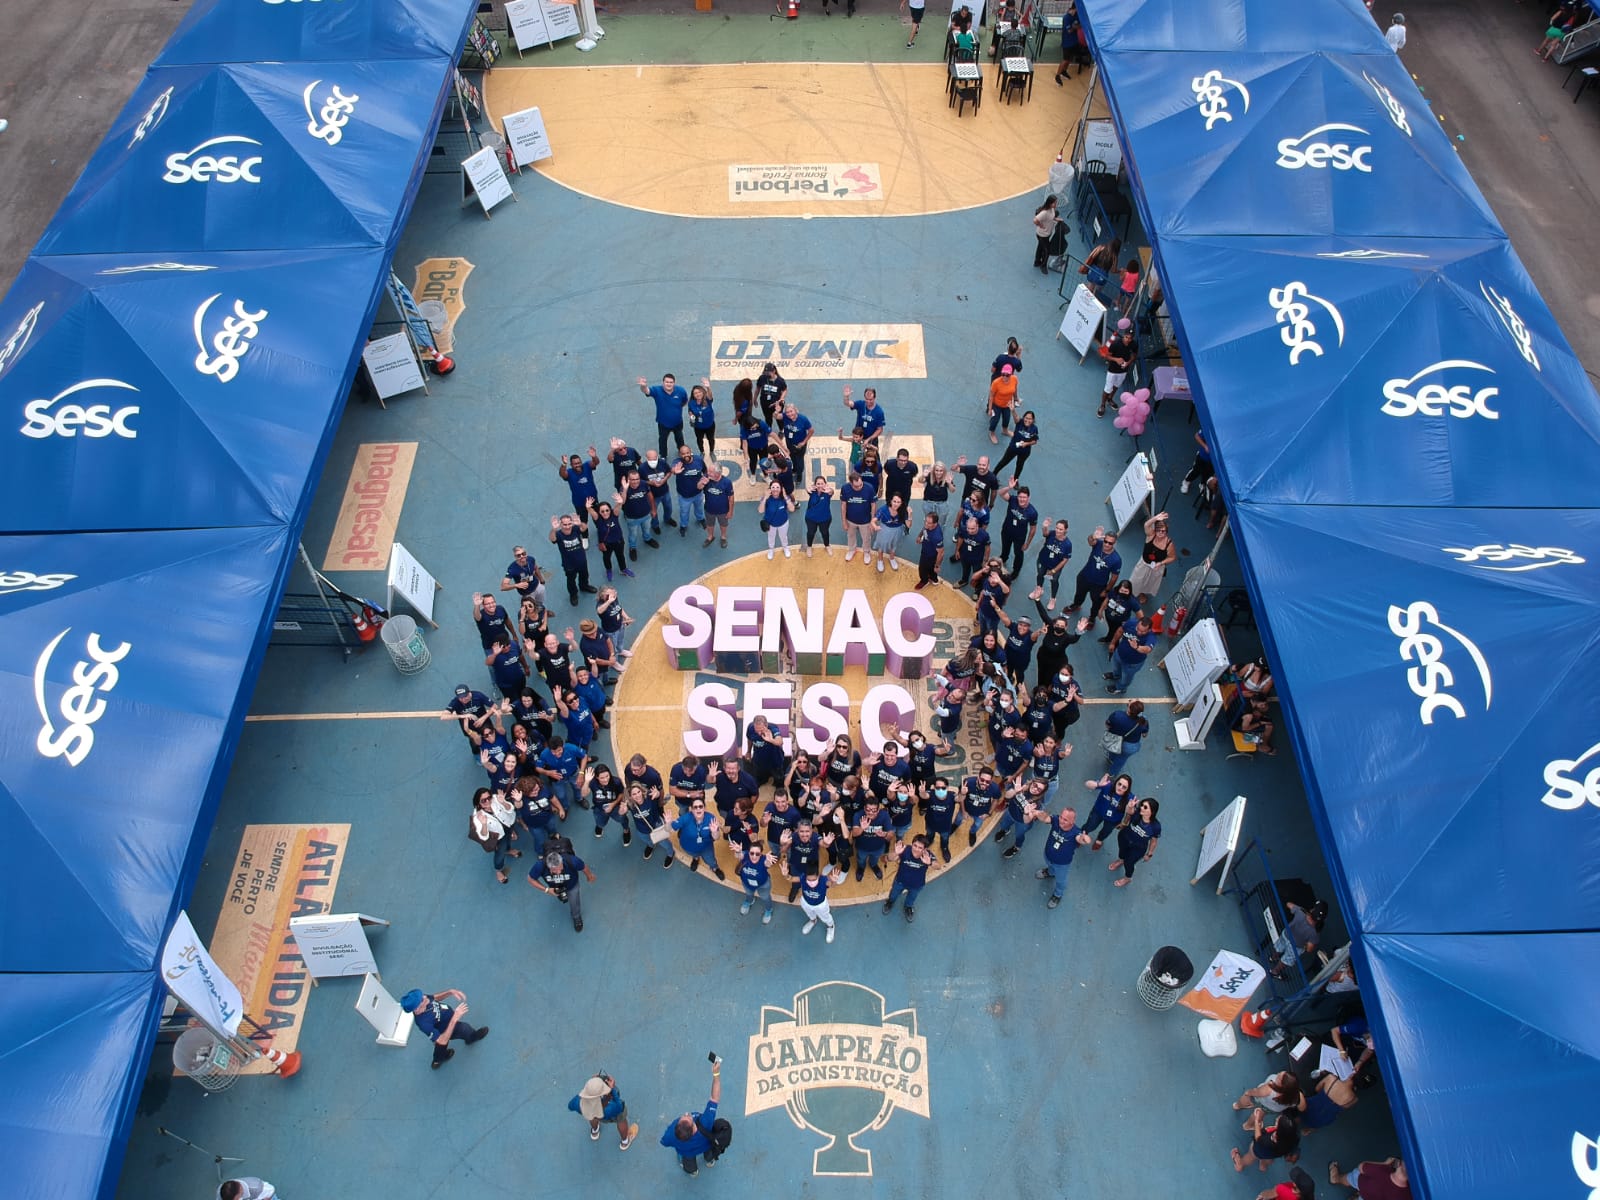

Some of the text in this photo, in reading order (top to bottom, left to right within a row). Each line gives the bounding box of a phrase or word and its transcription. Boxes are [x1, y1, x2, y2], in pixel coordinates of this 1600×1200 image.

[735, 179, 830, 196] Perboni
[715, 335, 899, 361] DIMAÇO
[794, 360, 846, 368] PRODUTOS
[343, 445, 400, 565] magnesat
[662, 584, 937, 658] SENAC
[683, 682, 916, 758] SESC
[264, 841, 287, 893] SEMPRE
[243, 868, 265, 915] PERTO
[262, 839, 339, 1031] ATLÂTIDA
[755, 1033, 922, 1074] CAMPEÃO
[756, 1064, 923, 1098] DA CONSTRUÇÃO
